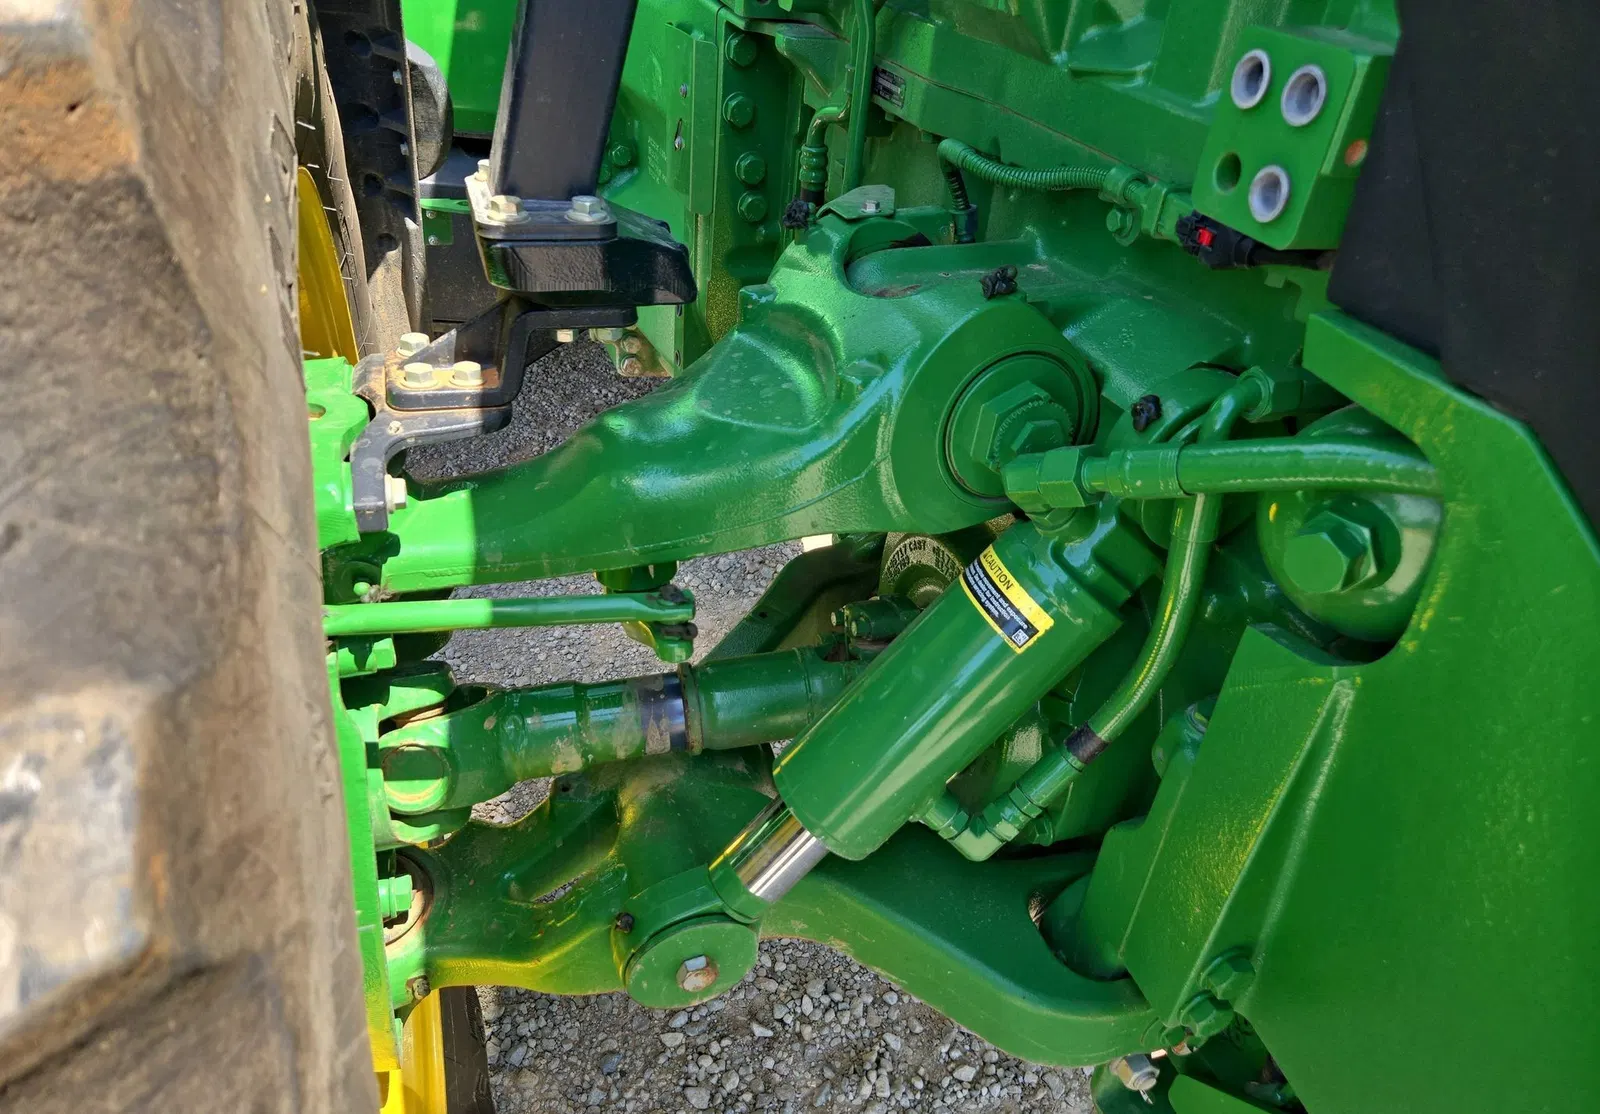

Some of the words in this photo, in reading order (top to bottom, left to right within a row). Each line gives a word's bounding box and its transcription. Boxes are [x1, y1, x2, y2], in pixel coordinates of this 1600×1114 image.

[909, 539, 927, 552] CAST
[985, 554, 1013, 590] CAUTION
[997, 597, 1008, 608] and
[1006, 606, 1028, 629] exposure
